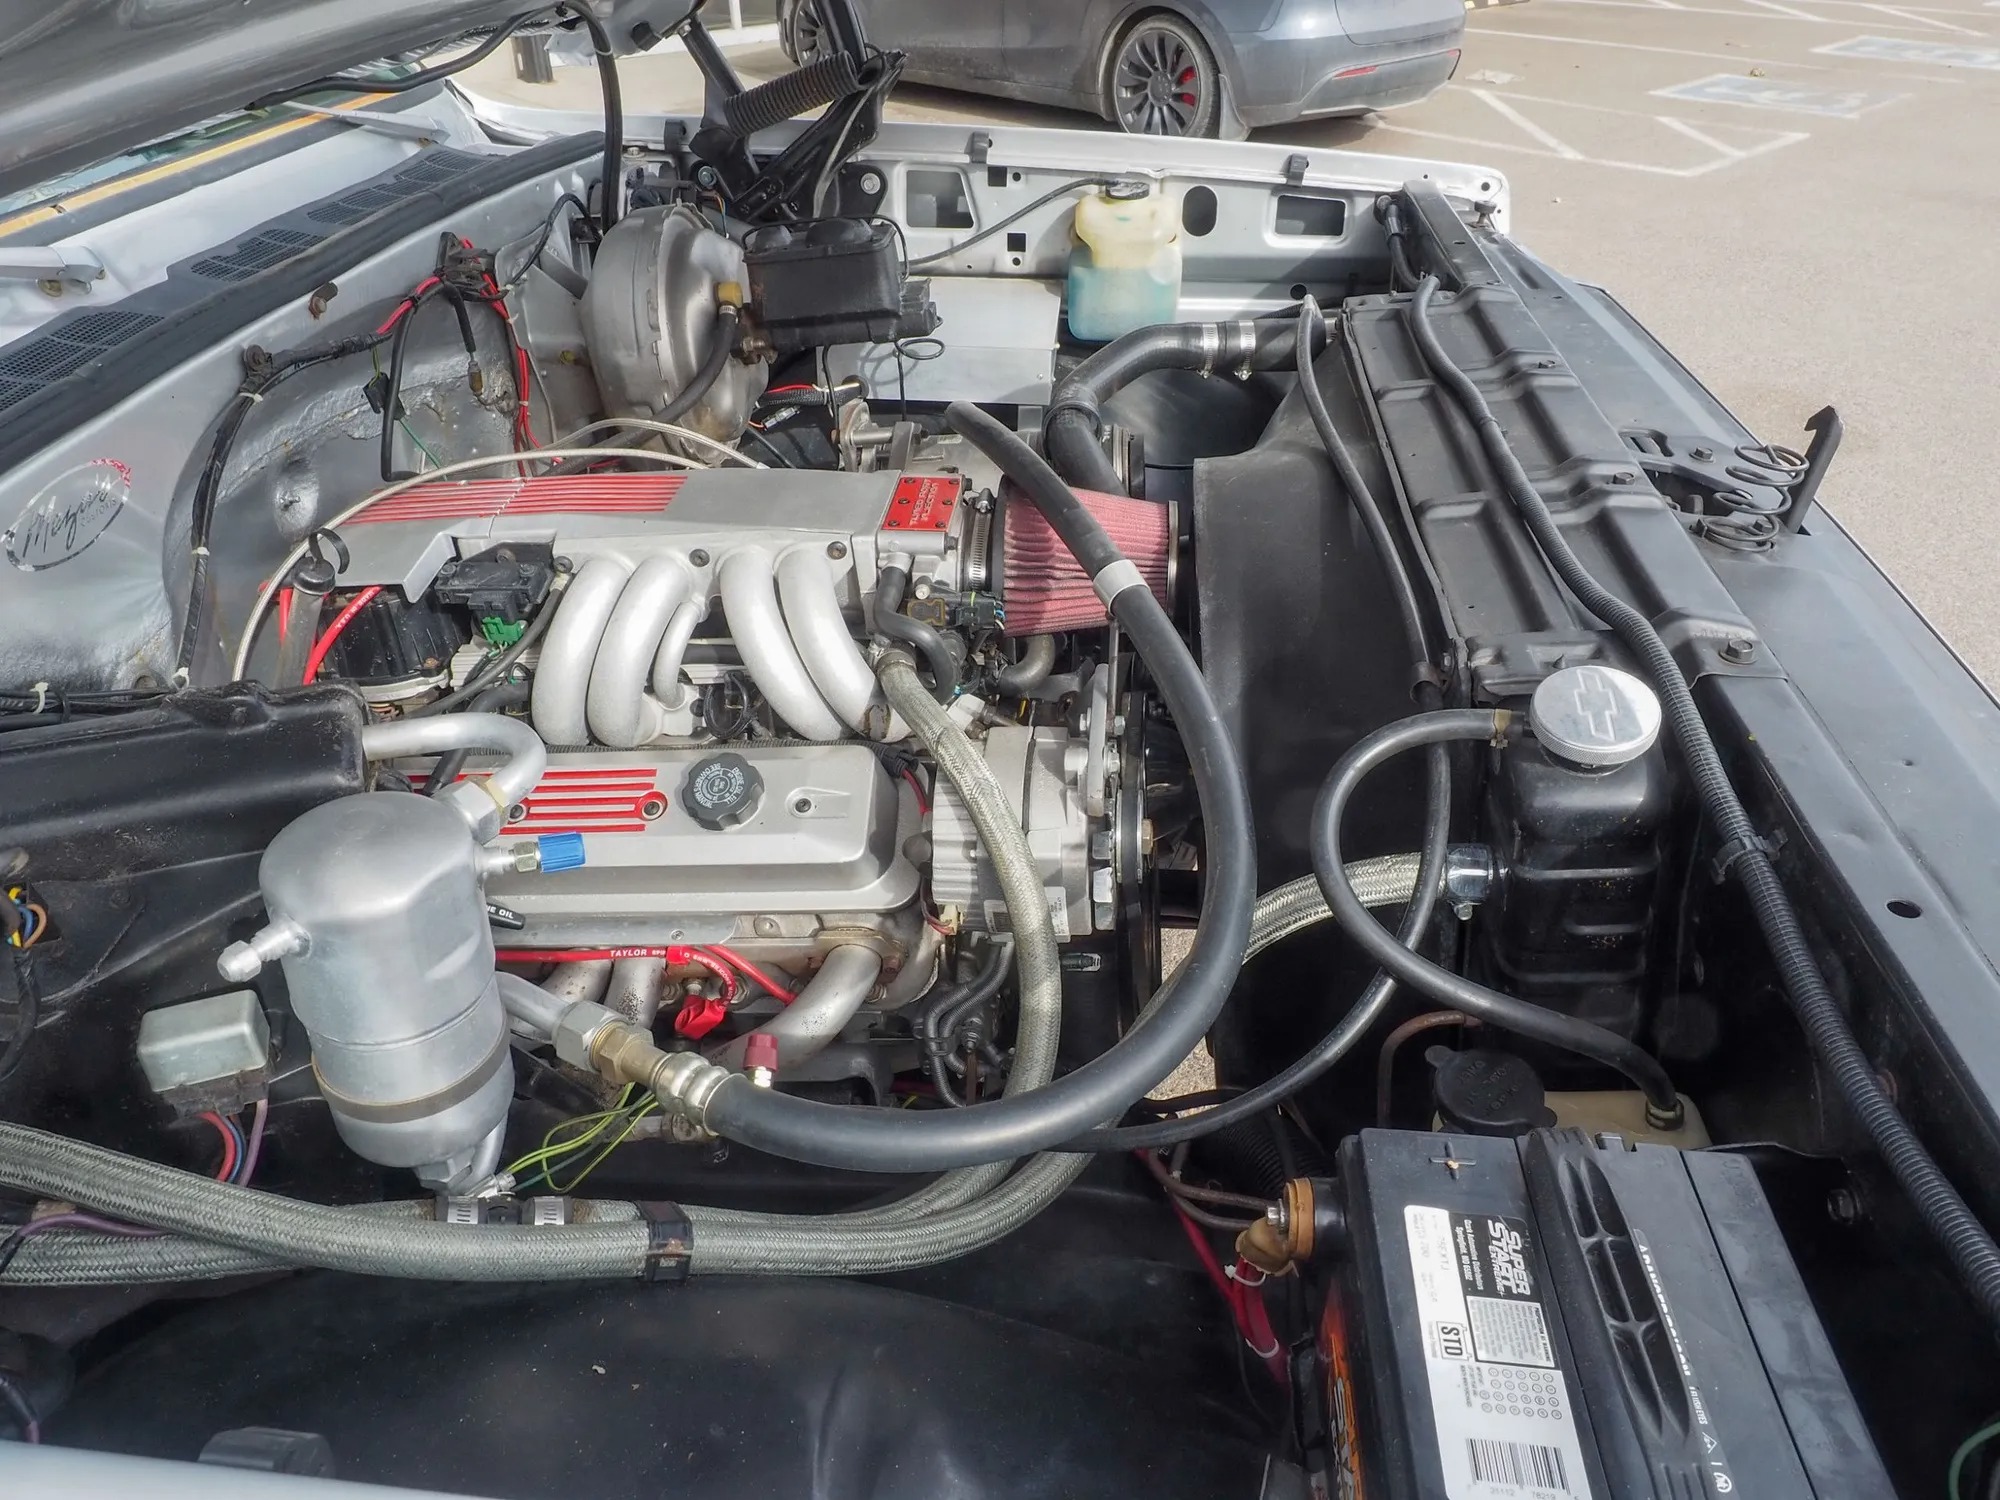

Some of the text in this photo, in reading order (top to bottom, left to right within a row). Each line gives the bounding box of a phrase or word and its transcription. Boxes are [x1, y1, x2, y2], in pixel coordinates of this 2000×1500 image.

[921, 482, 940, 521] INJECTION
[358, 590, 375, 606] MADE
[498, 908, 514, 919] OIL
[610, 949, 648, 957] TAYLOR
[1466, 1234, 1479, 1261] Automotive
[1487, 1219, 1518, 1295] START
[1472, 1260, 1484, 1291] Distributors
[1504, 1231, 1531, 1295] SUPER
[1441, 1326, 1464, 1357] STD
[1696, 1409, 1709, 1425] EYES
